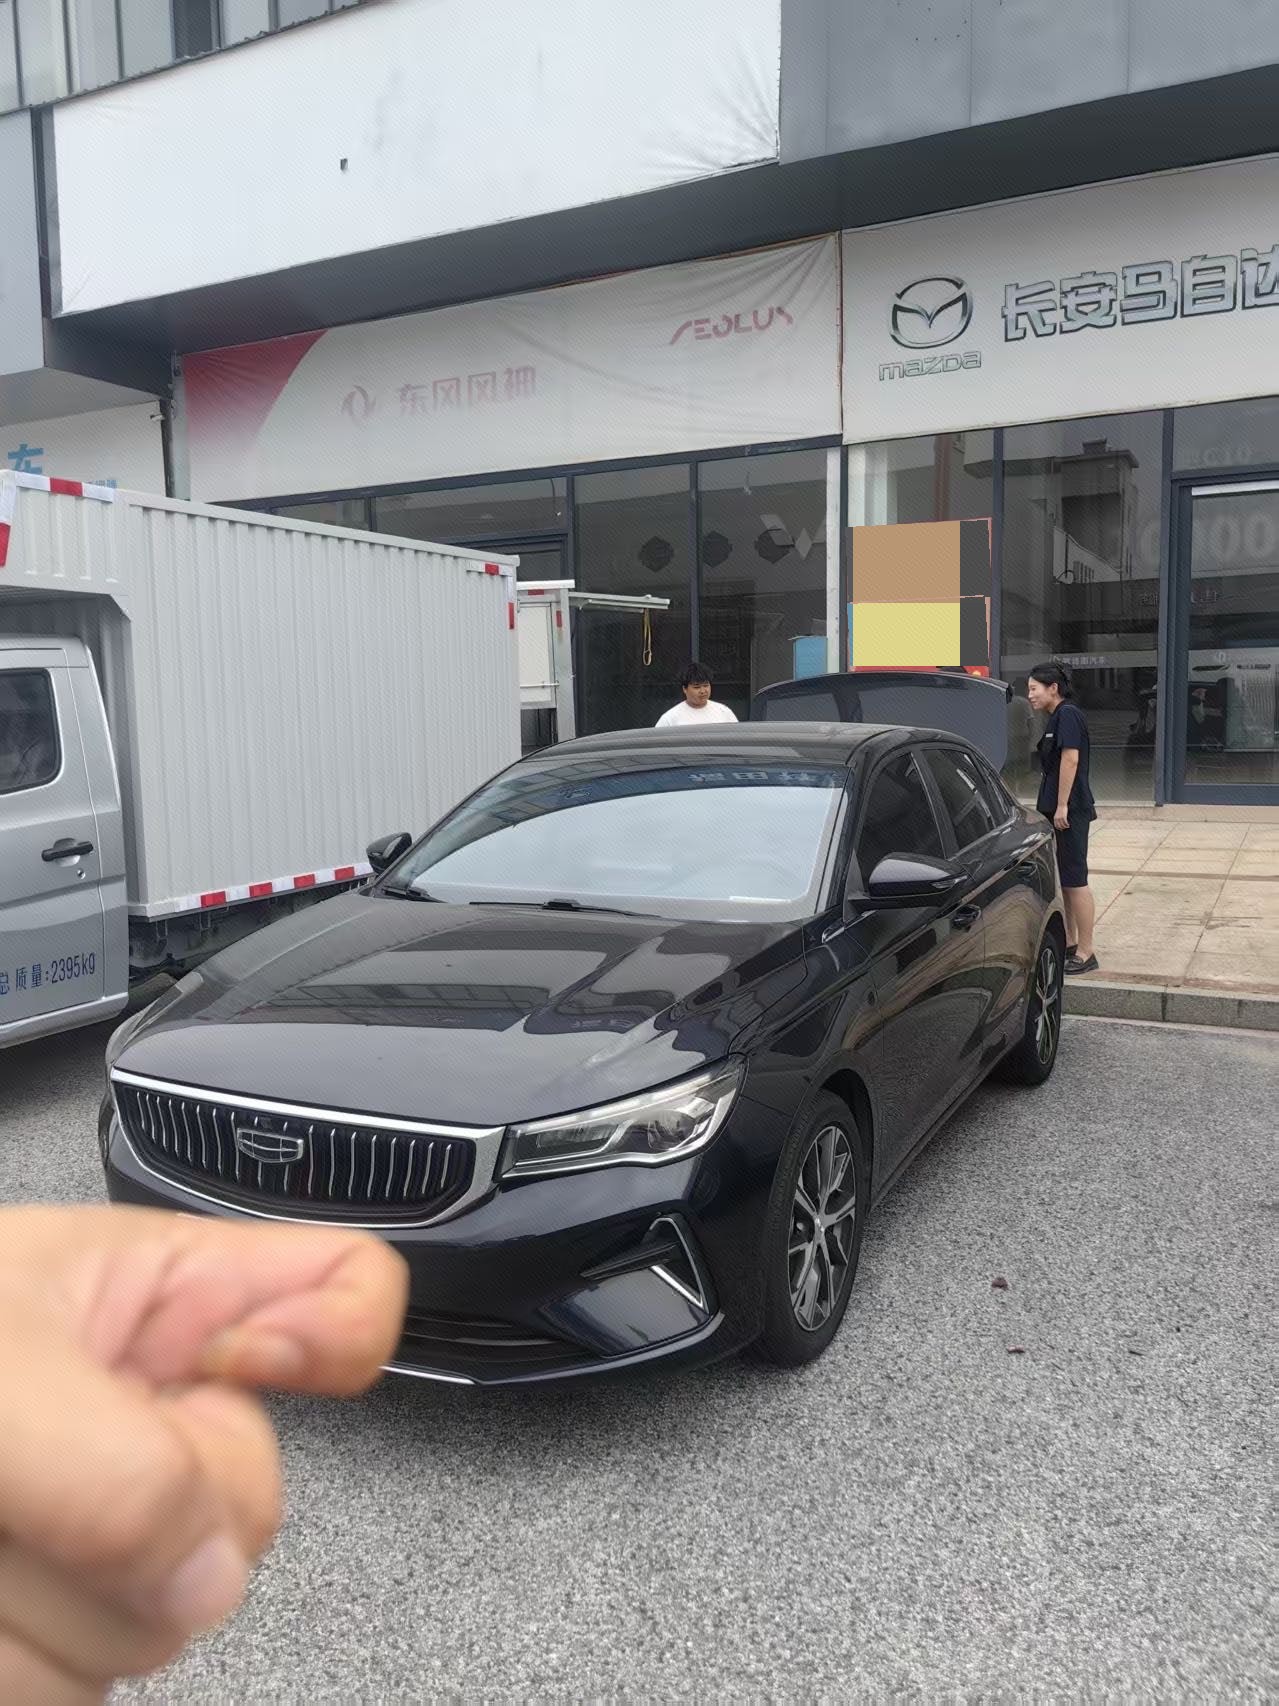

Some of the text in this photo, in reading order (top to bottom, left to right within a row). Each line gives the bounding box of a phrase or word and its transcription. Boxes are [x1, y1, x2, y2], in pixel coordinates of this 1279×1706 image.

[1001, 243, 1279, 342] 长安马自达
